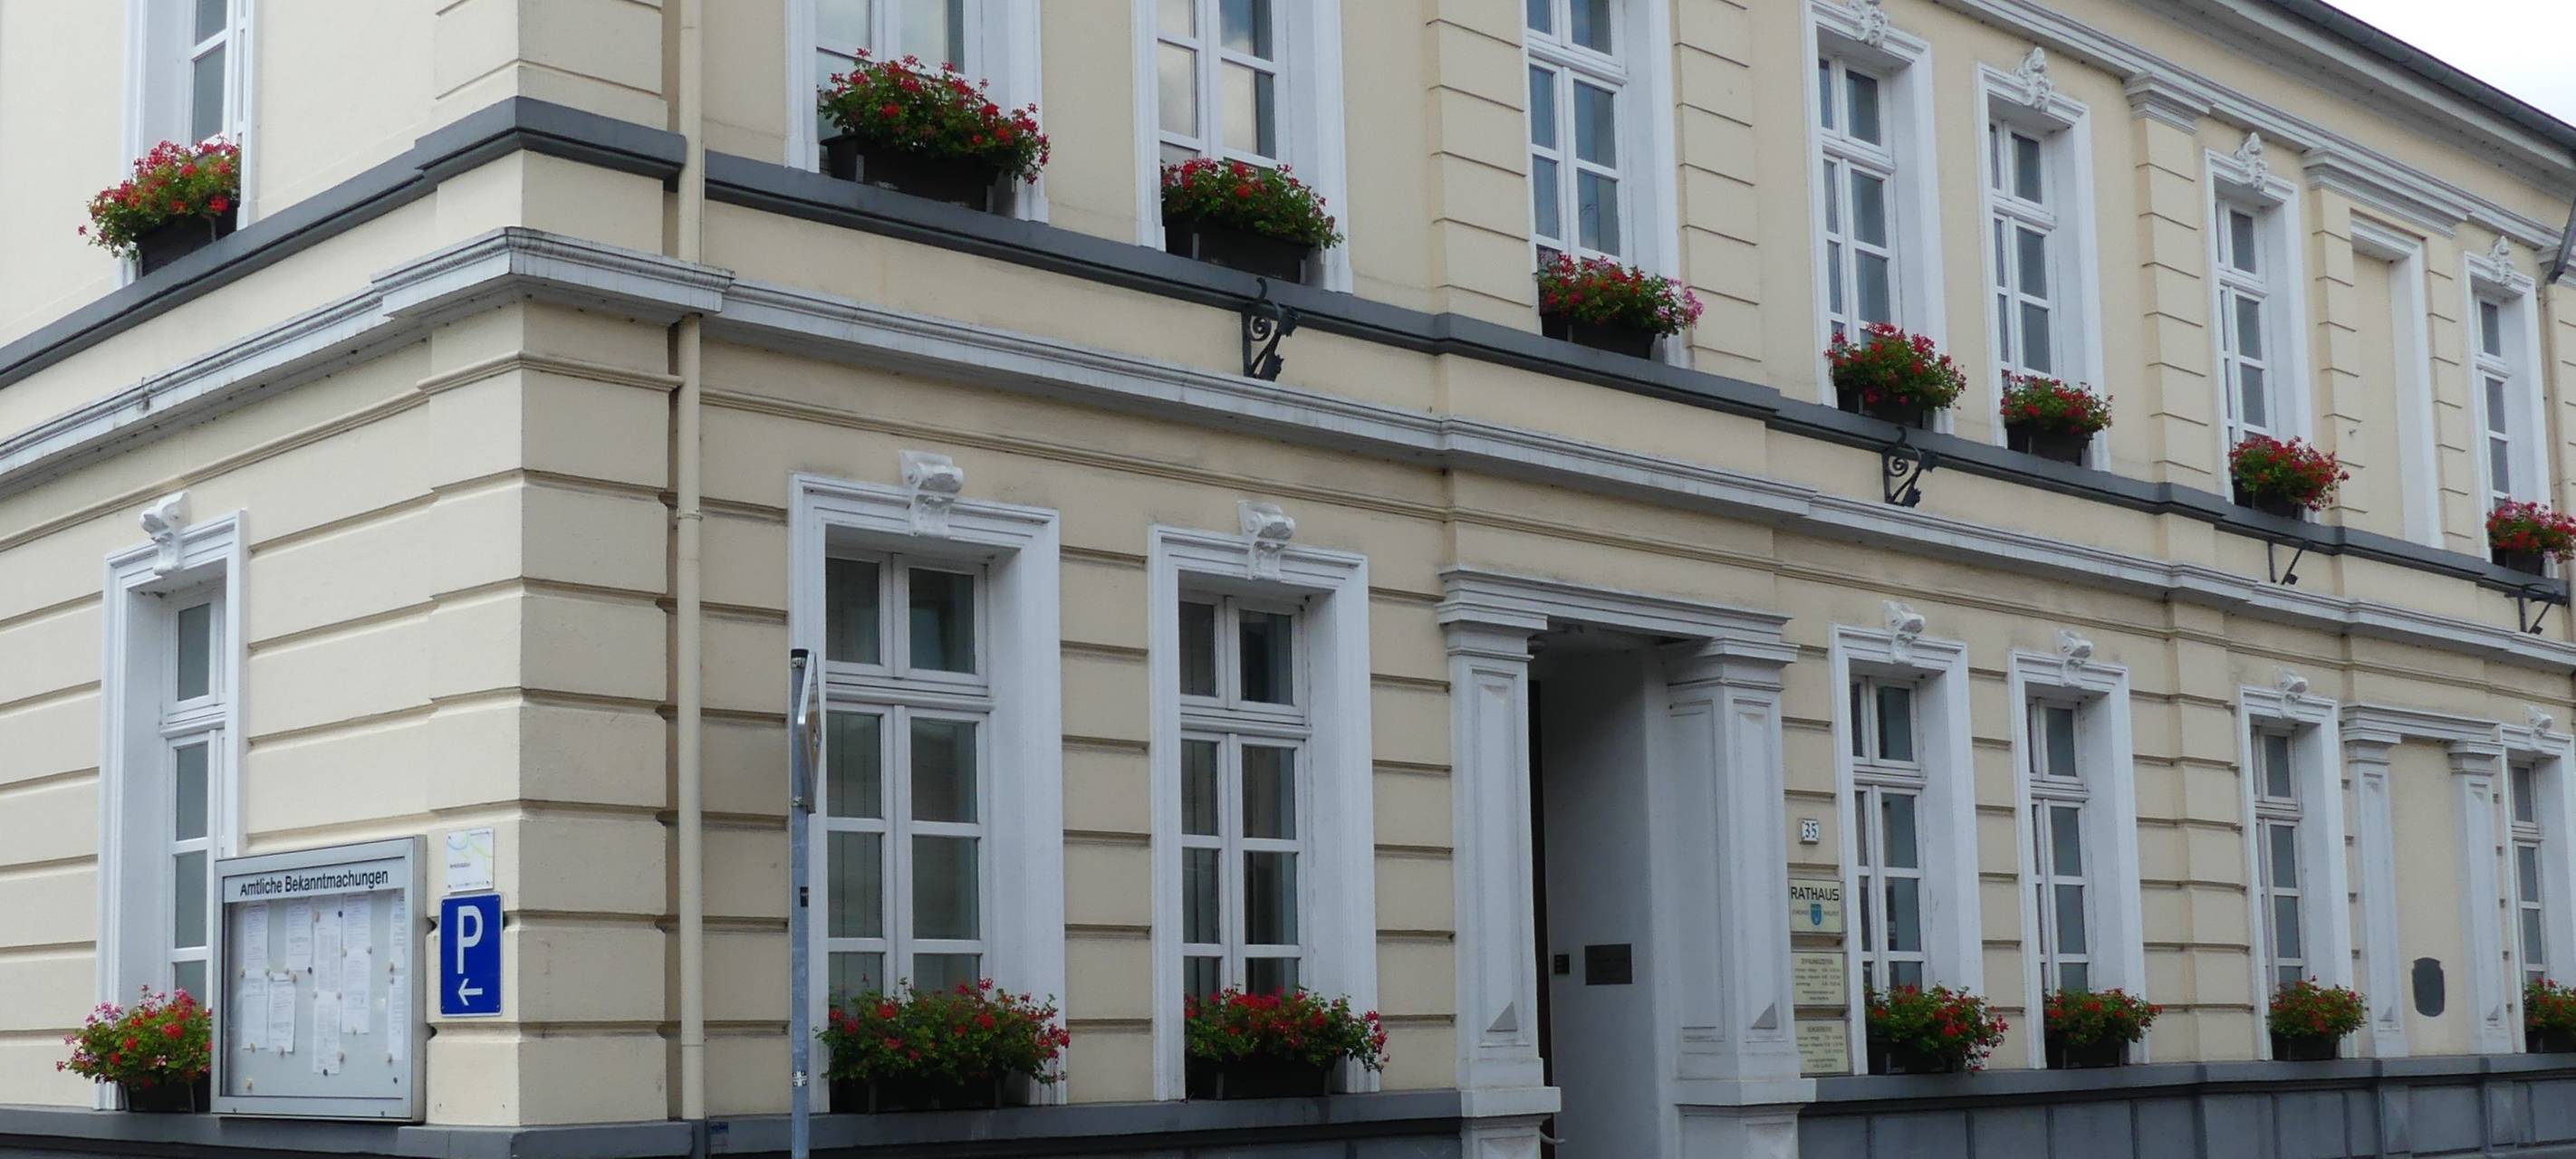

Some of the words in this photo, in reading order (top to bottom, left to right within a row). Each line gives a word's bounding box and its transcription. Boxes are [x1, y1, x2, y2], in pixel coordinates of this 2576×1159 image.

[1805, 823, 1817, 838] 35
[240, 877, 282, 896] Amtliche
[285, 869, 389, 888] Bekanntmachungen
[1791, 886, 1840, 901] RATHAUS
[457, 905, 484, 974] P
